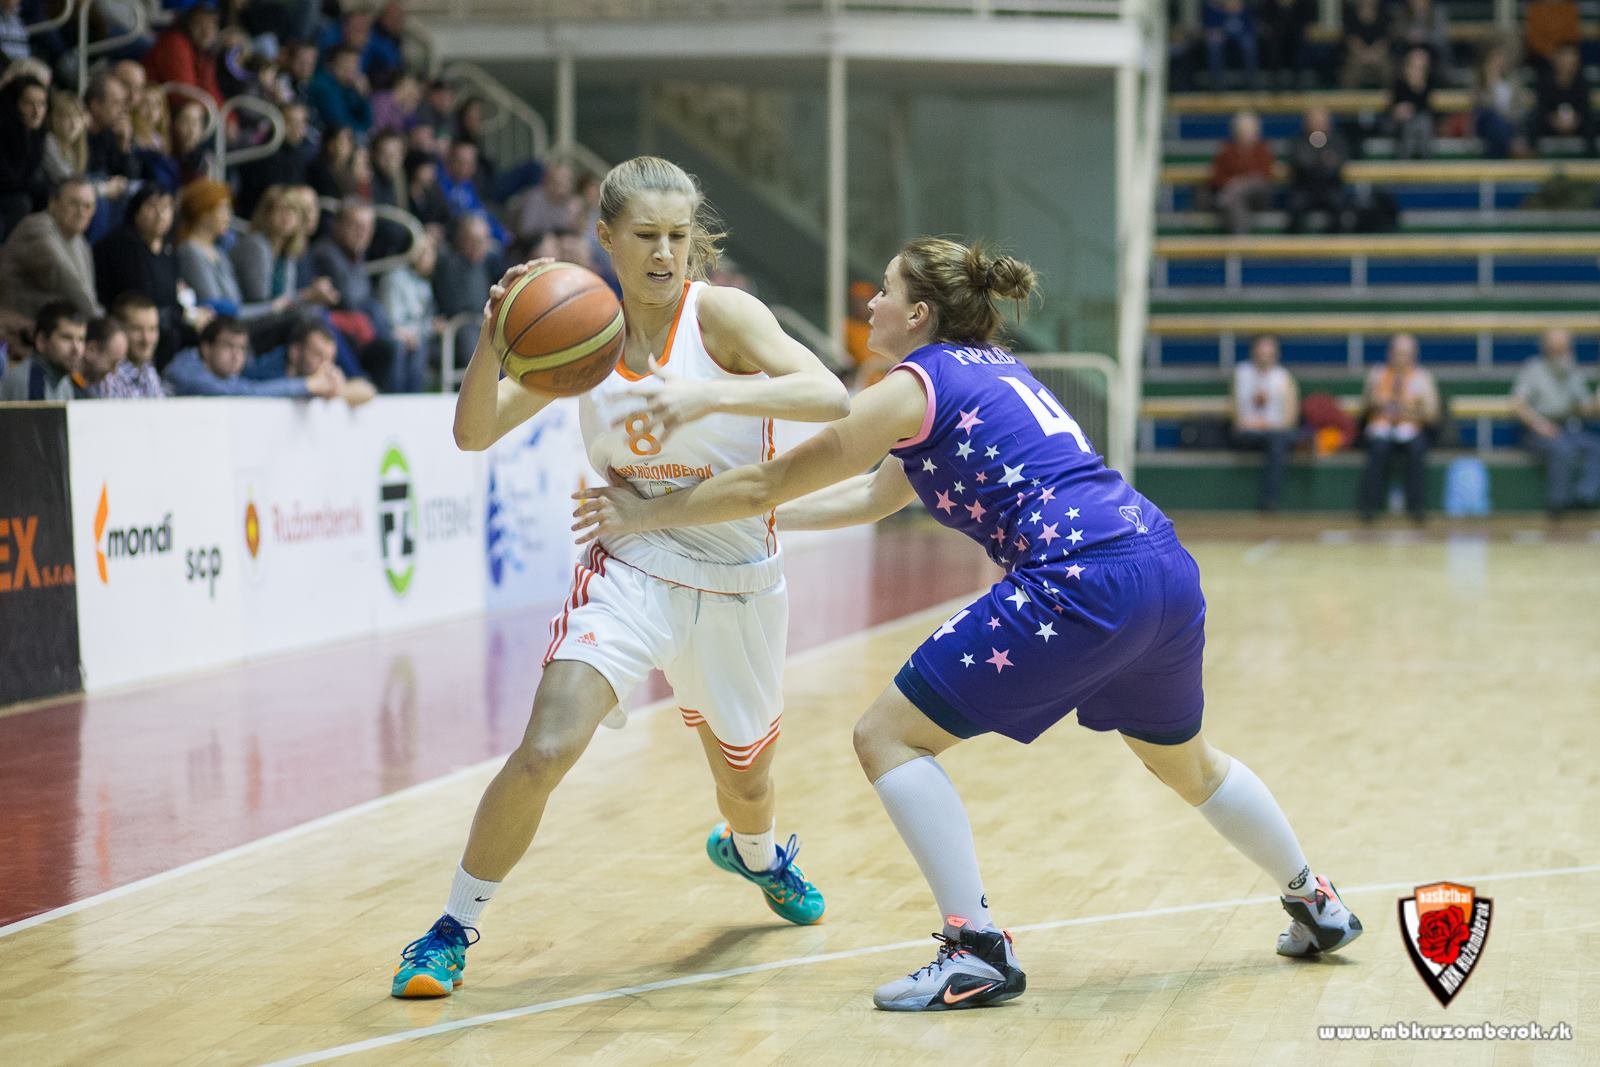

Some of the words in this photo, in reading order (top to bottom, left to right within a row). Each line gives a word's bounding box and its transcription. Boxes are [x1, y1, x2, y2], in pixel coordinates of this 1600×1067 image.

[625, 412, 661, 456] 8
[998, 376, 1092, 454] 4
[186, 546, 221, 599] scp
